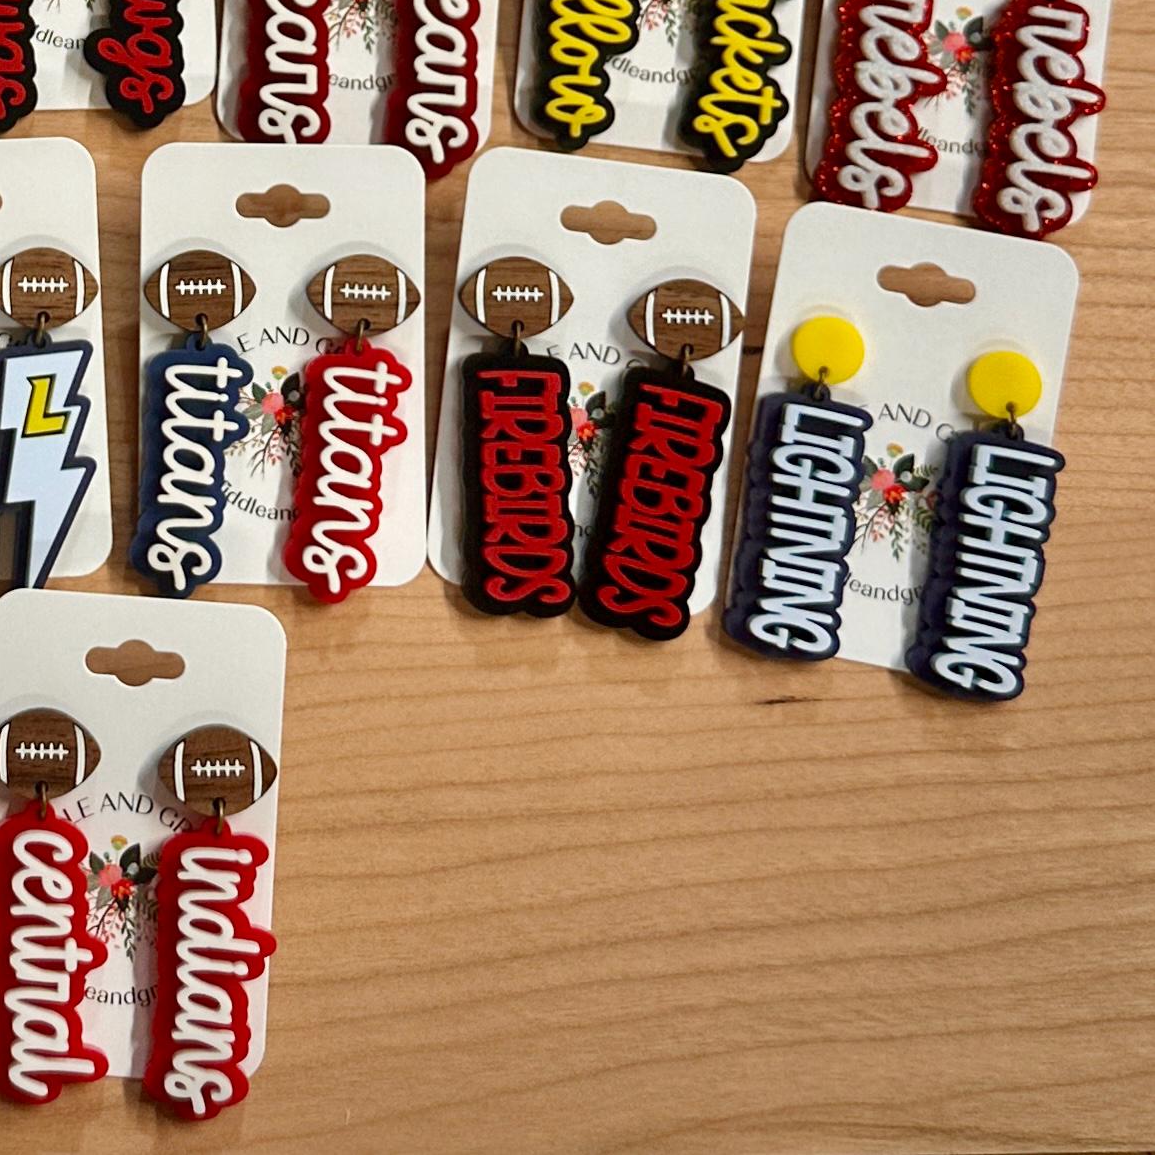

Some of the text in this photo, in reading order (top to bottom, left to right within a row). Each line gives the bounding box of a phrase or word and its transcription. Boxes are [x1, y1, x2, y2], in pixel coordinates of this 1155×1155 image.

[998, 5, 1101, 233] rebels
[20, 372, 72, 439] L
[259, 325, 311, 348] AND
[567, 342, 621, 369] AND
[877, 401, 933, 430] AND
[147, 356, 244, 591] titans
[301, 360, 403, 594] titans
[476, 369, 572, 604] FIREBIRDS
[597, 382, 724, 628] FIREBIRDS
[749, 402, 864, 653] LIGHTNING
[932, 444, 1056, 694] LIGHTNING
[100, 790, 154, 818] AND
[4, 828, 96, 1098] central
[163, 845, 262, 1116] indians
